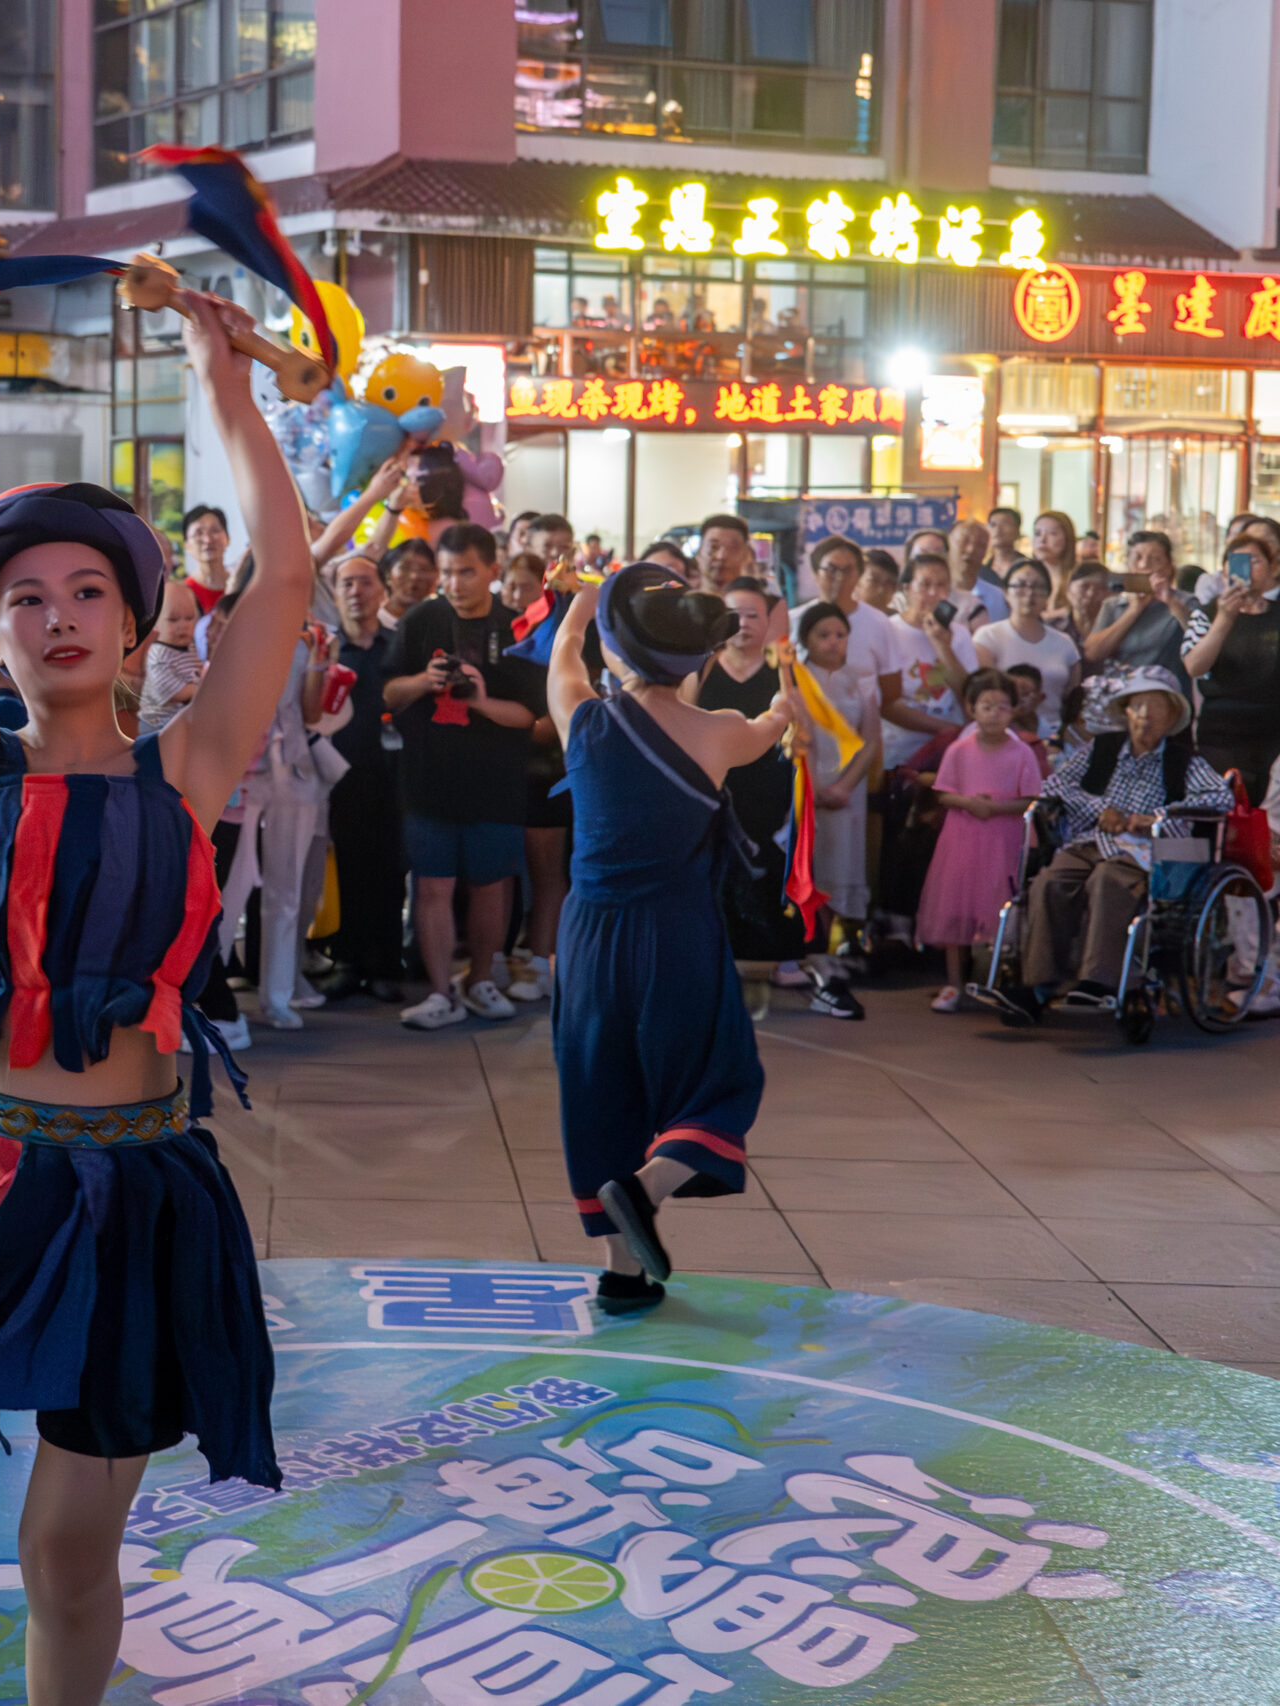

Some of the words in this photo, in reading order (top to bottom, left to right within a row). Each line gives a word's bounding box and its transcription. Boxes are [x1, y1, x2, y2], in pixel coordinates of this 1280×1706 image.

[123, 1376, 618, 1538] 我们这样过夏天
[300, 1454, 1121, 1706] 浪漫宣
